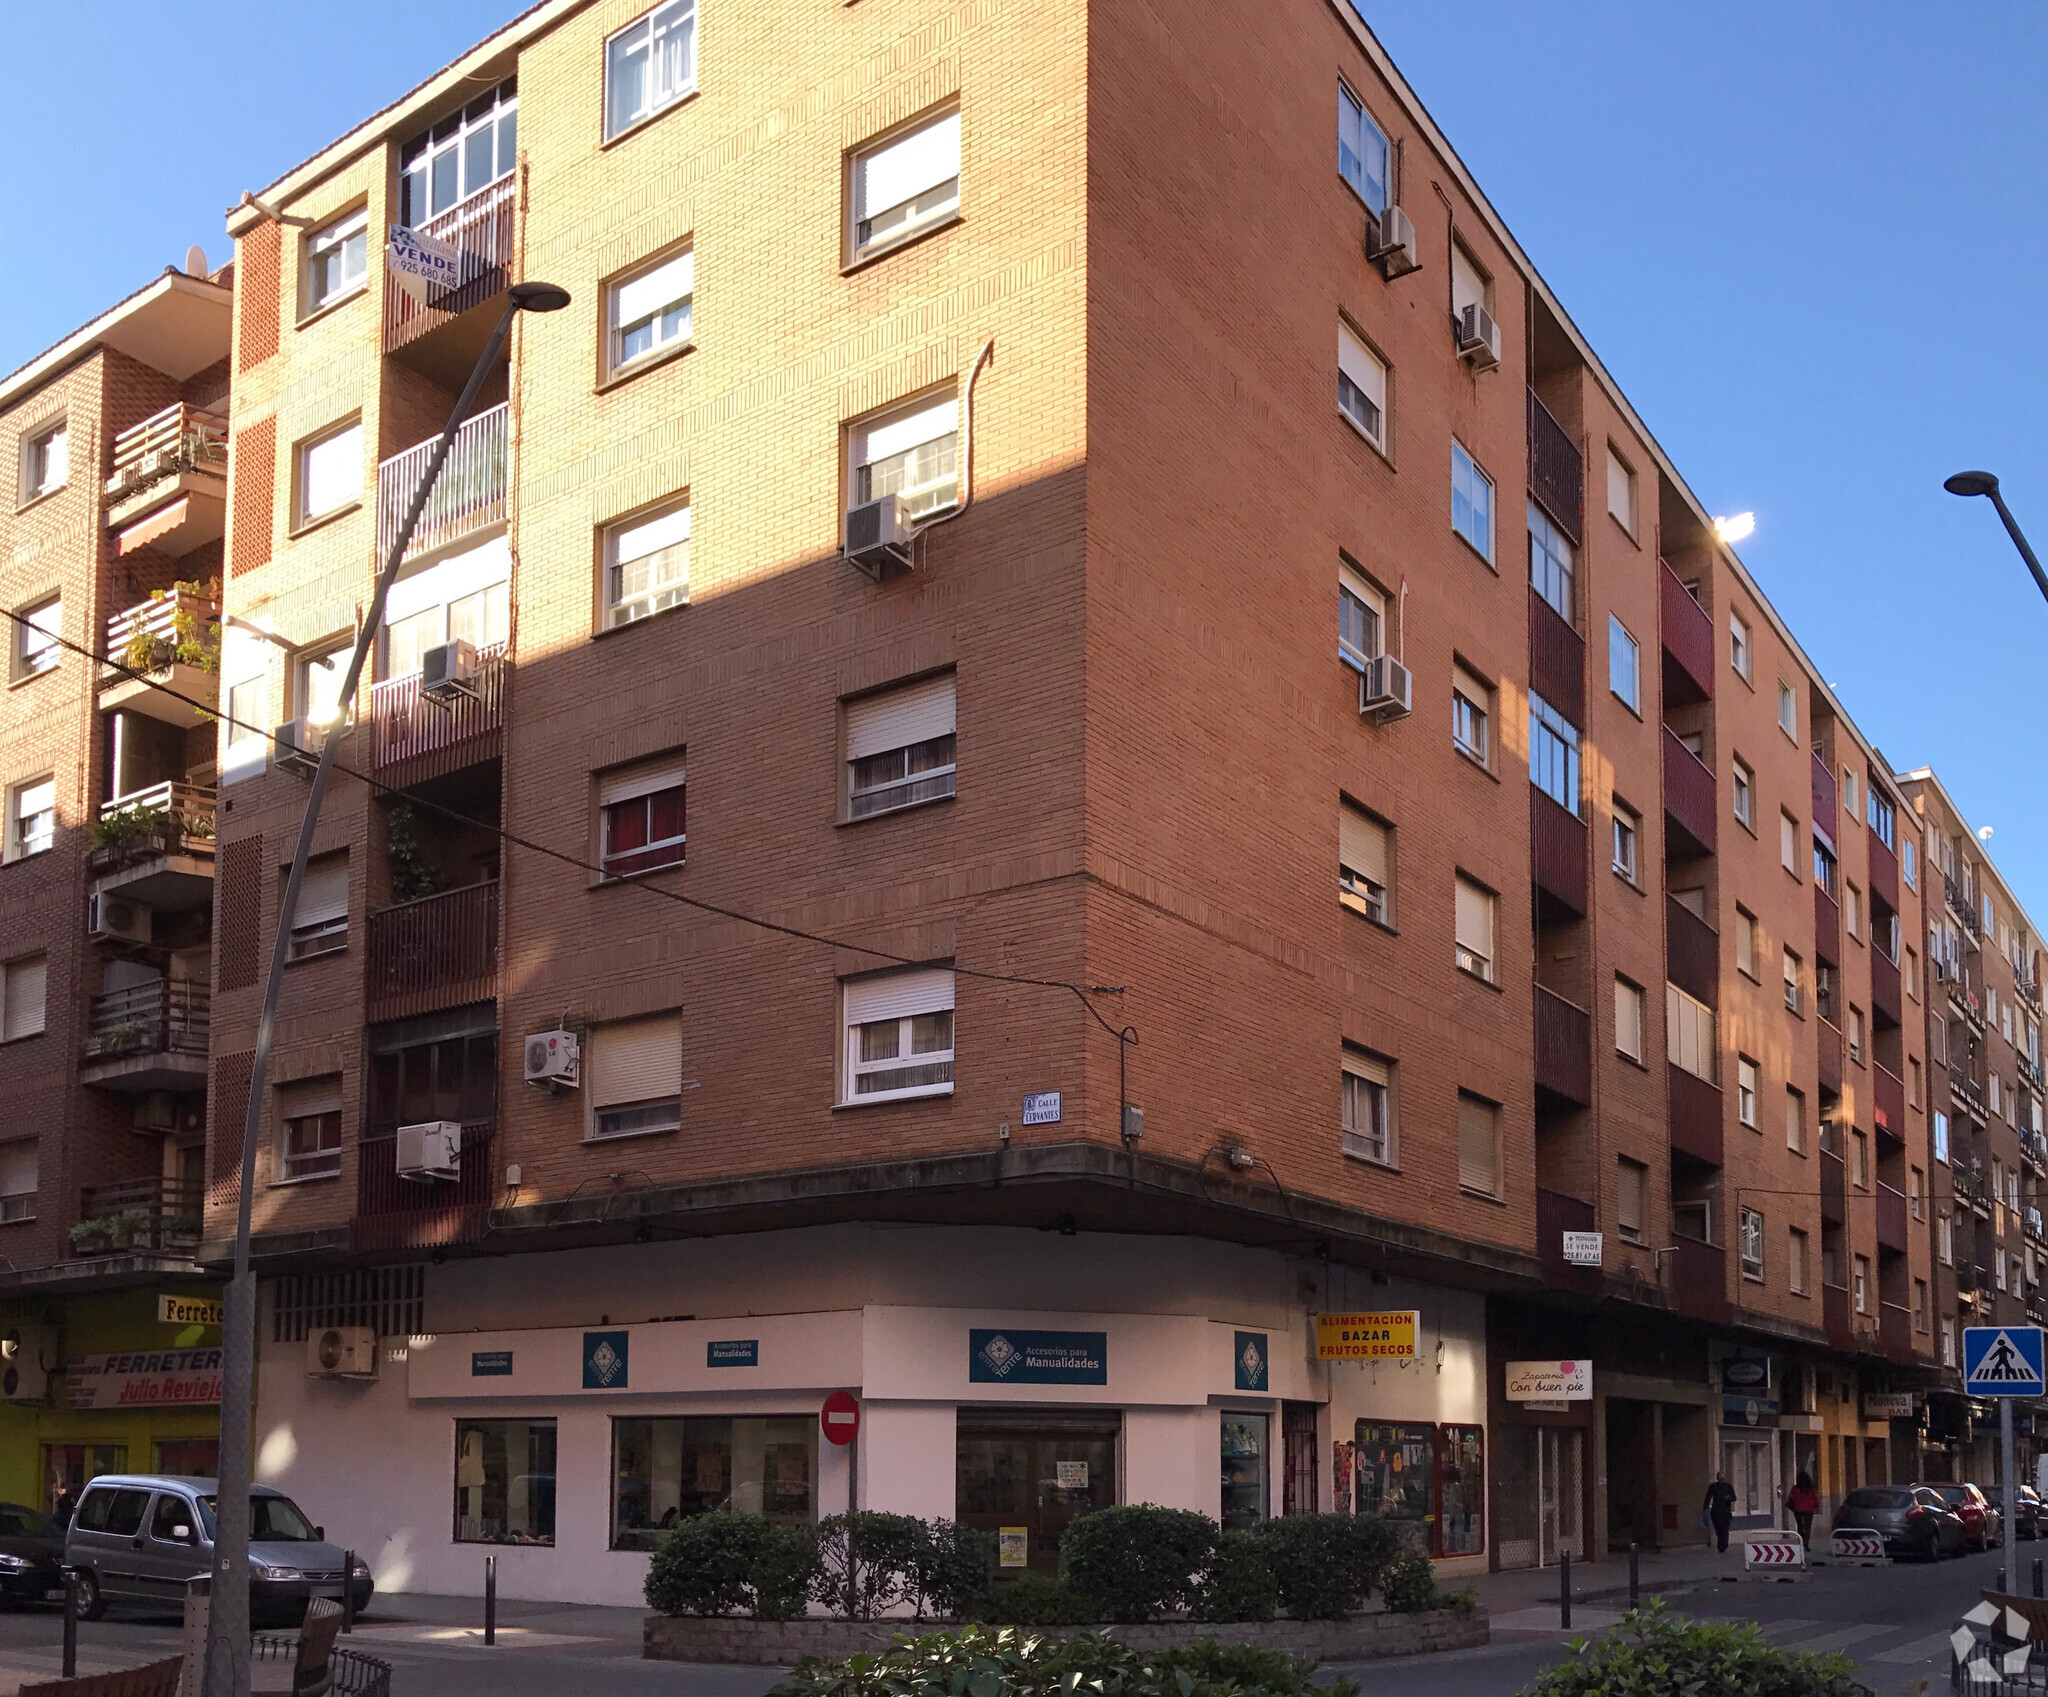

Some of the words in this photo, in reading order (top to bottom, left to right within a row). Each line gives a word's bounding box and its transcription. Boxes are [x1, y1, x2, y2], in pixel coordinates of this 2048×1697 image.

[393, 244, 457, 275] VENDE
[401, 260, 418, 274] 925
[421, 266, 439, 280] 680
[441, 273, 457, 288] 685
[1038, 1098, 1058, 1107] CALLE
[1025, 1110, 1059, 1122] CERVANTES
[1575, 1243, 1598, 1251] VENDE
[1321, 1313, 1412, 1326] ALIMENTACIÓN
[1341, 1330, 1390, 1341] BAZAR
[713, 1350, 752, 1358] Manualidades
[1025, 1346, 1068, 1356] Accesorios
[1070, 1348, 1088, 1357] para
[1319, 1345, 1368, 1355] FRUTOS
[1371, 1344, 1413, 1355] SECOS
[103, 1350, 223, 1375] FERRETER
[1026, 1357, 1099, 1369] Manualidades
[119, 1378, 158, 1401] Julio
[1510, 1381, 1531, 1392] Con
[1535, 1381, 1563, 1392] buen
[1565, 1382, 1584, 1395] pie
